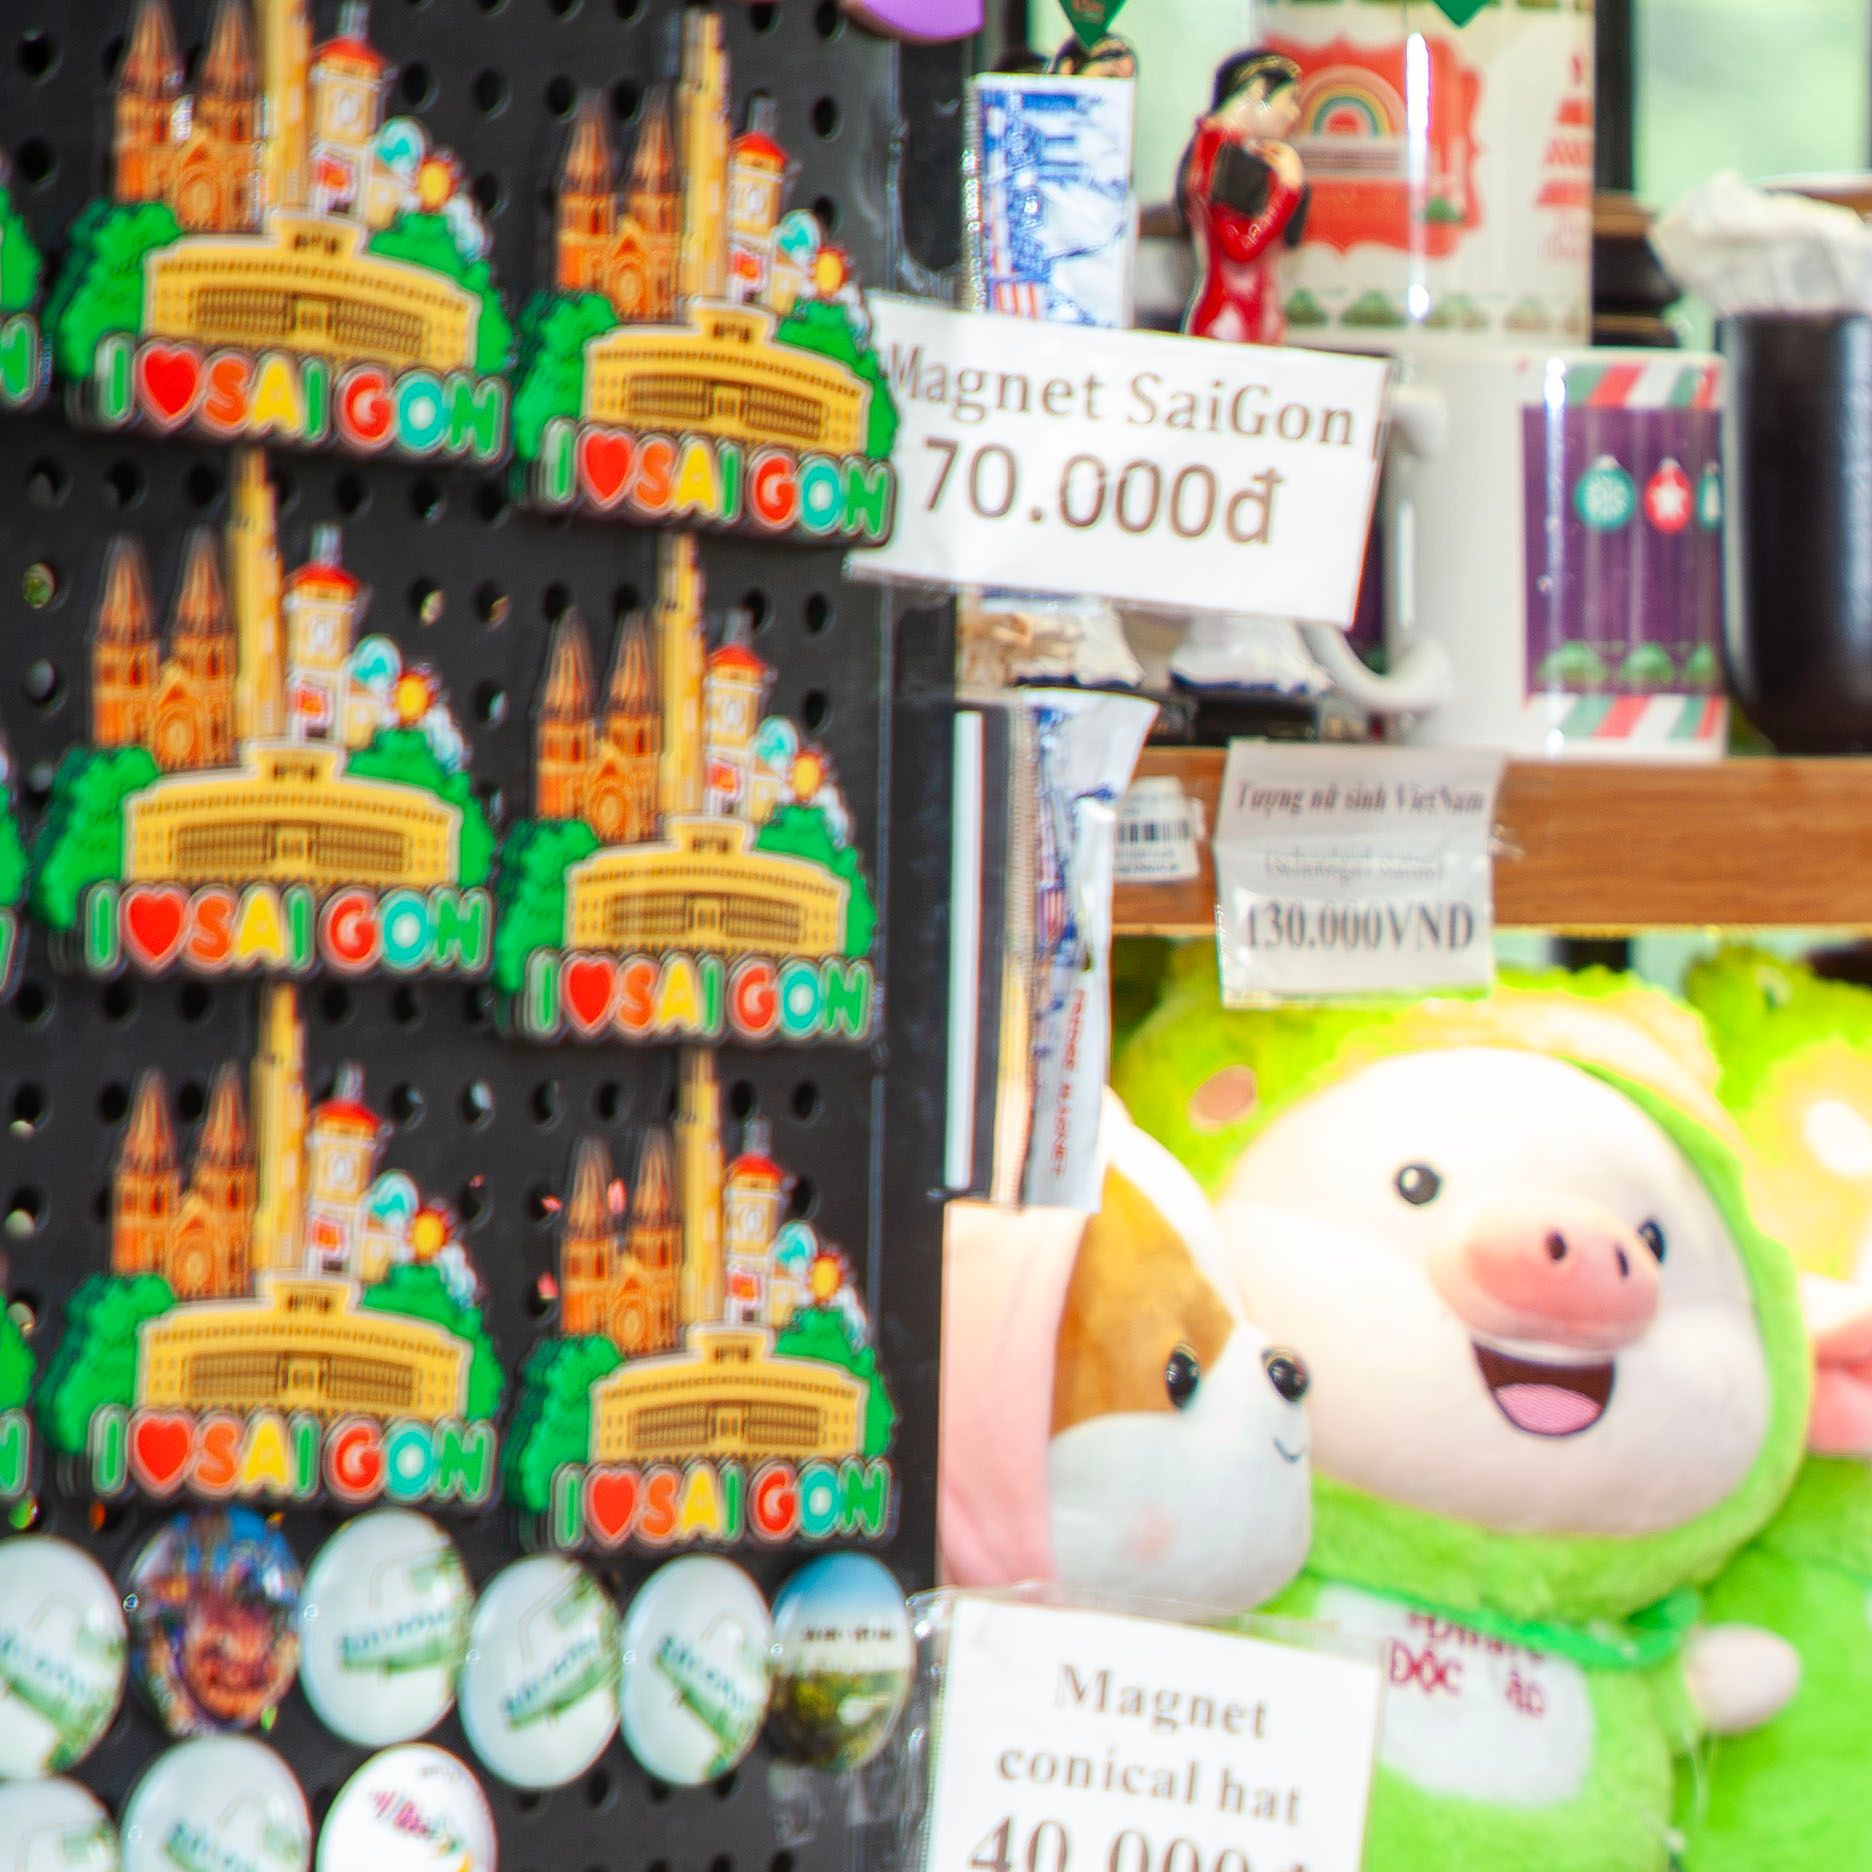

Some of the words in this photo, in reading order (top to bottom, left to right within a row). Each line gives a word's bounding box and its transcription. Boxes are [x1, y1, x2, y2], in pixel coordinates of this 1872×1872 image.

[887, 341, 1104, 427] Magnet
[1128, 371, 1355, 448] SaiGon
[924, 436, 1283, 546] 70.000đ
[1246, 901, 1475, 950] 130.000VND
[1054, 1662, 1270, 1740] Magnet
[996, 1743, 1198, 1807] conical
[1218, 1769, 1301, 1829] hat
